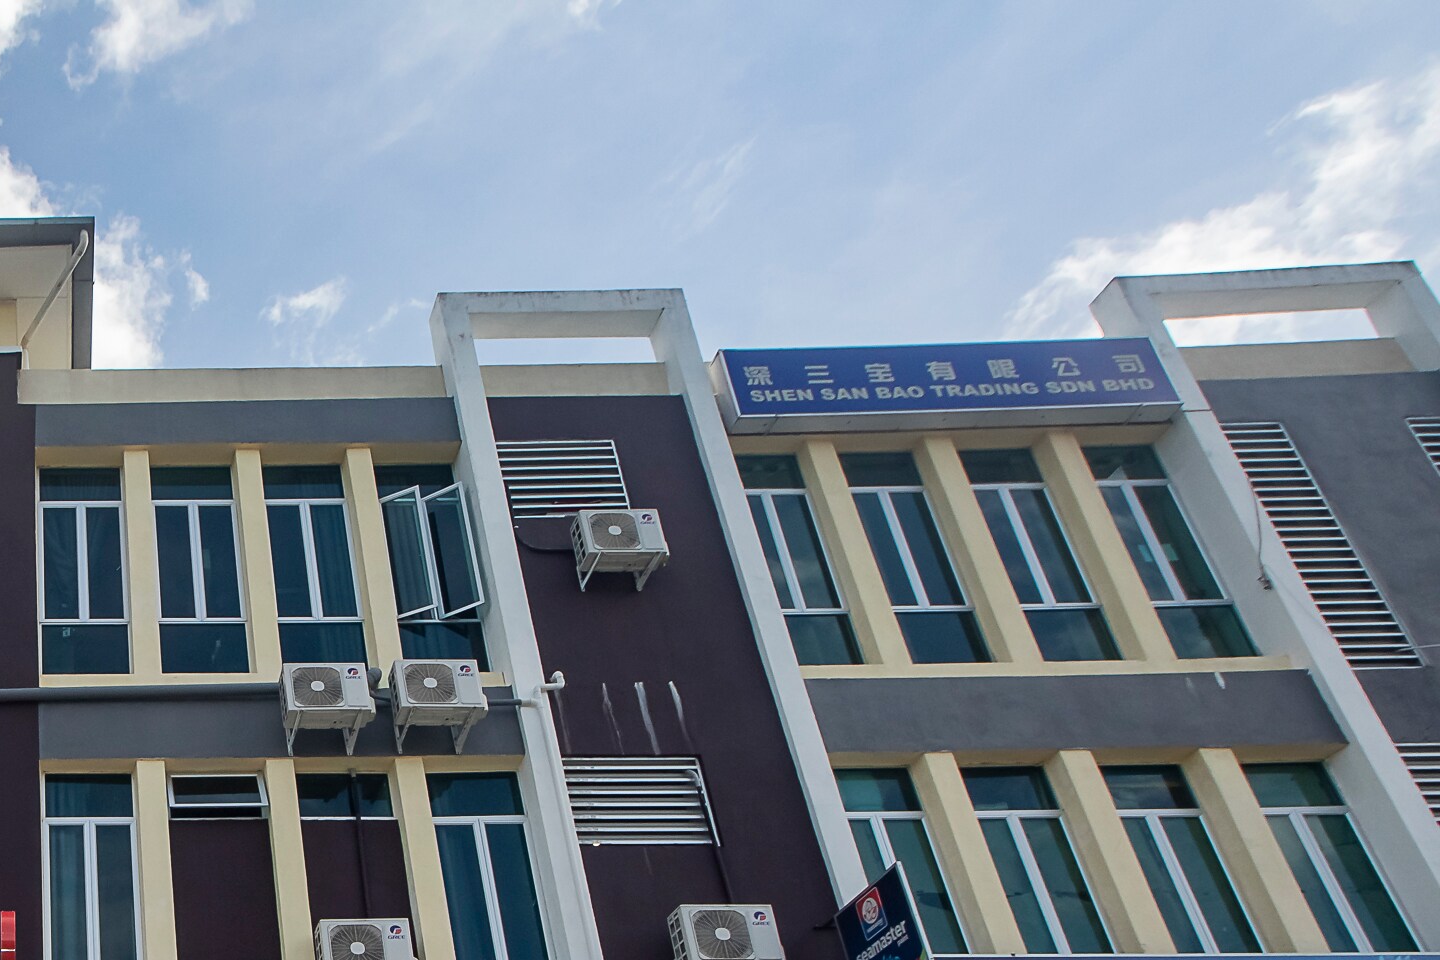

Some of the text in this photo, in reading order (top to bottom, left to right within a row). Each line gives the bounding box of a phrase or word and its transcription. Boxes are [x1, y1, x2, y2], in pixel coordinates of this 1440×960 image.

[749, 378, 1155, 403] SHEN SAN BAO TRADING SDN BHD
